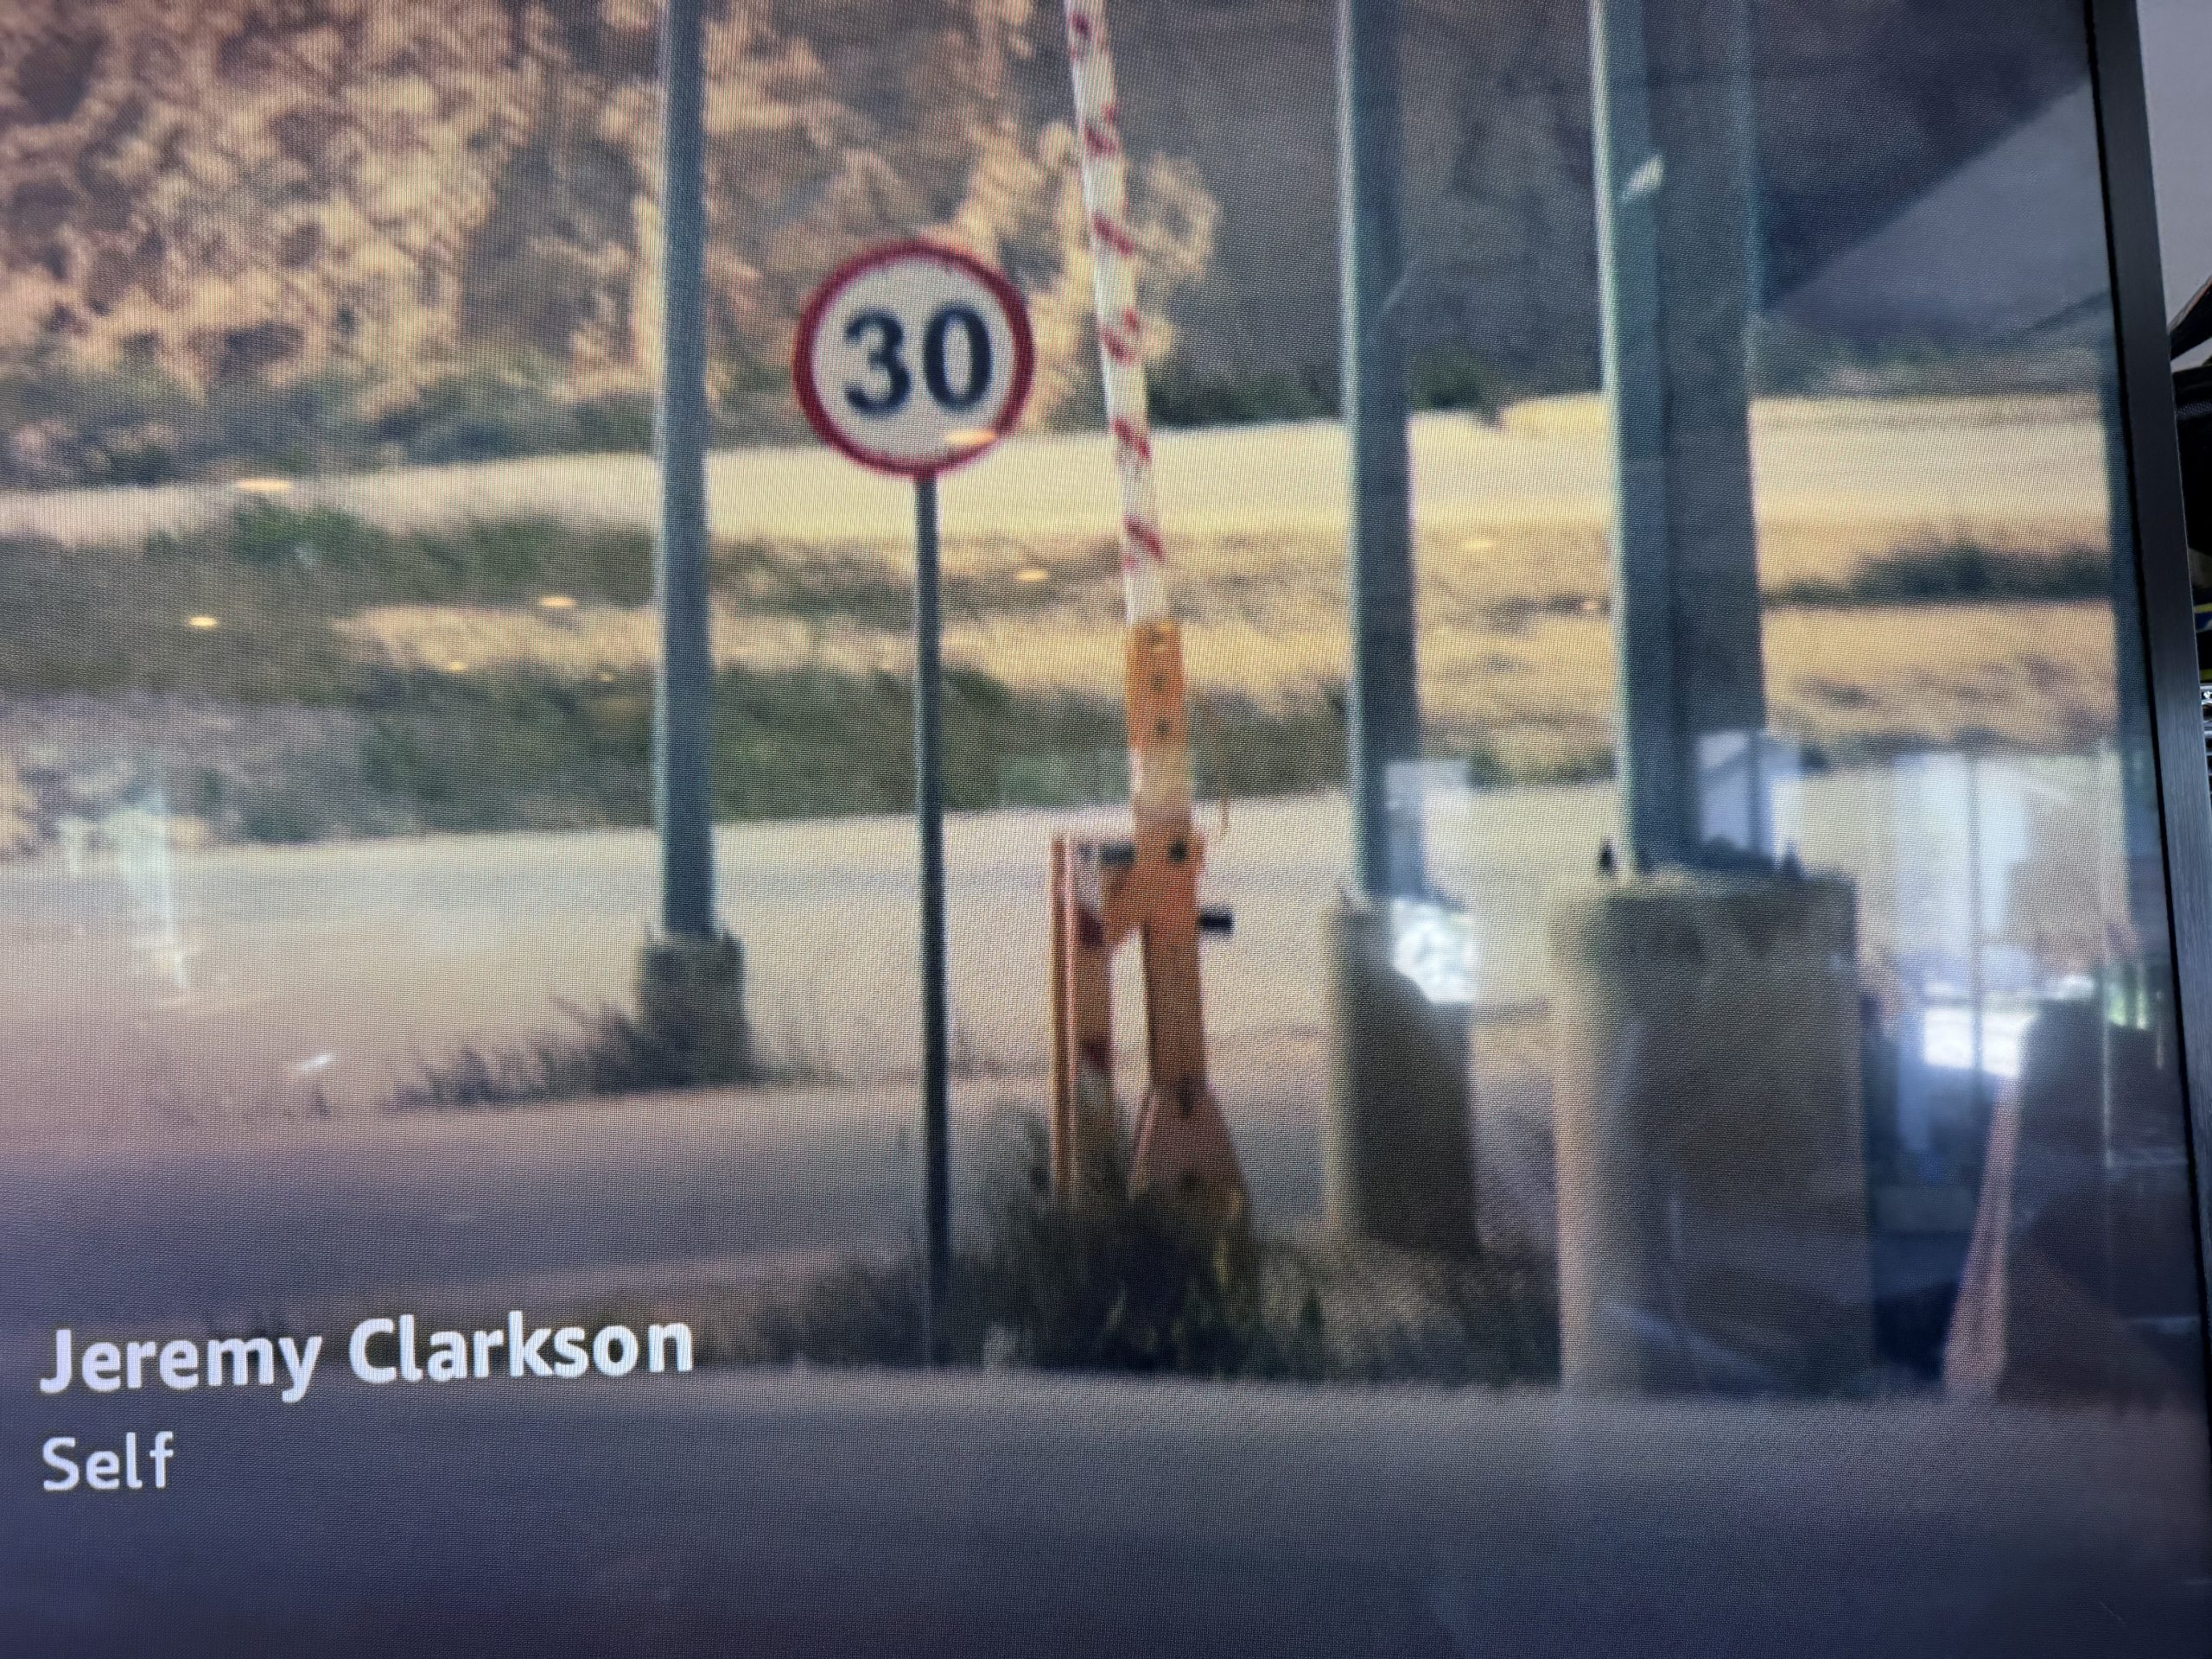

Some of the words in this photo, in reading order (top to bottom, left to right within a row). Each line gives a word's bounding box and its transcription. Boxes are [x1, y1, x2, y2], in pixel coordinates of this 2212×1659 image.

[843, 301, 991, 418] 30
[40, 1328, 323, 1404] Jeremy
[348, 1310, 694, 1385] Clarkson
[42, 1430, 175, 1491] Self
